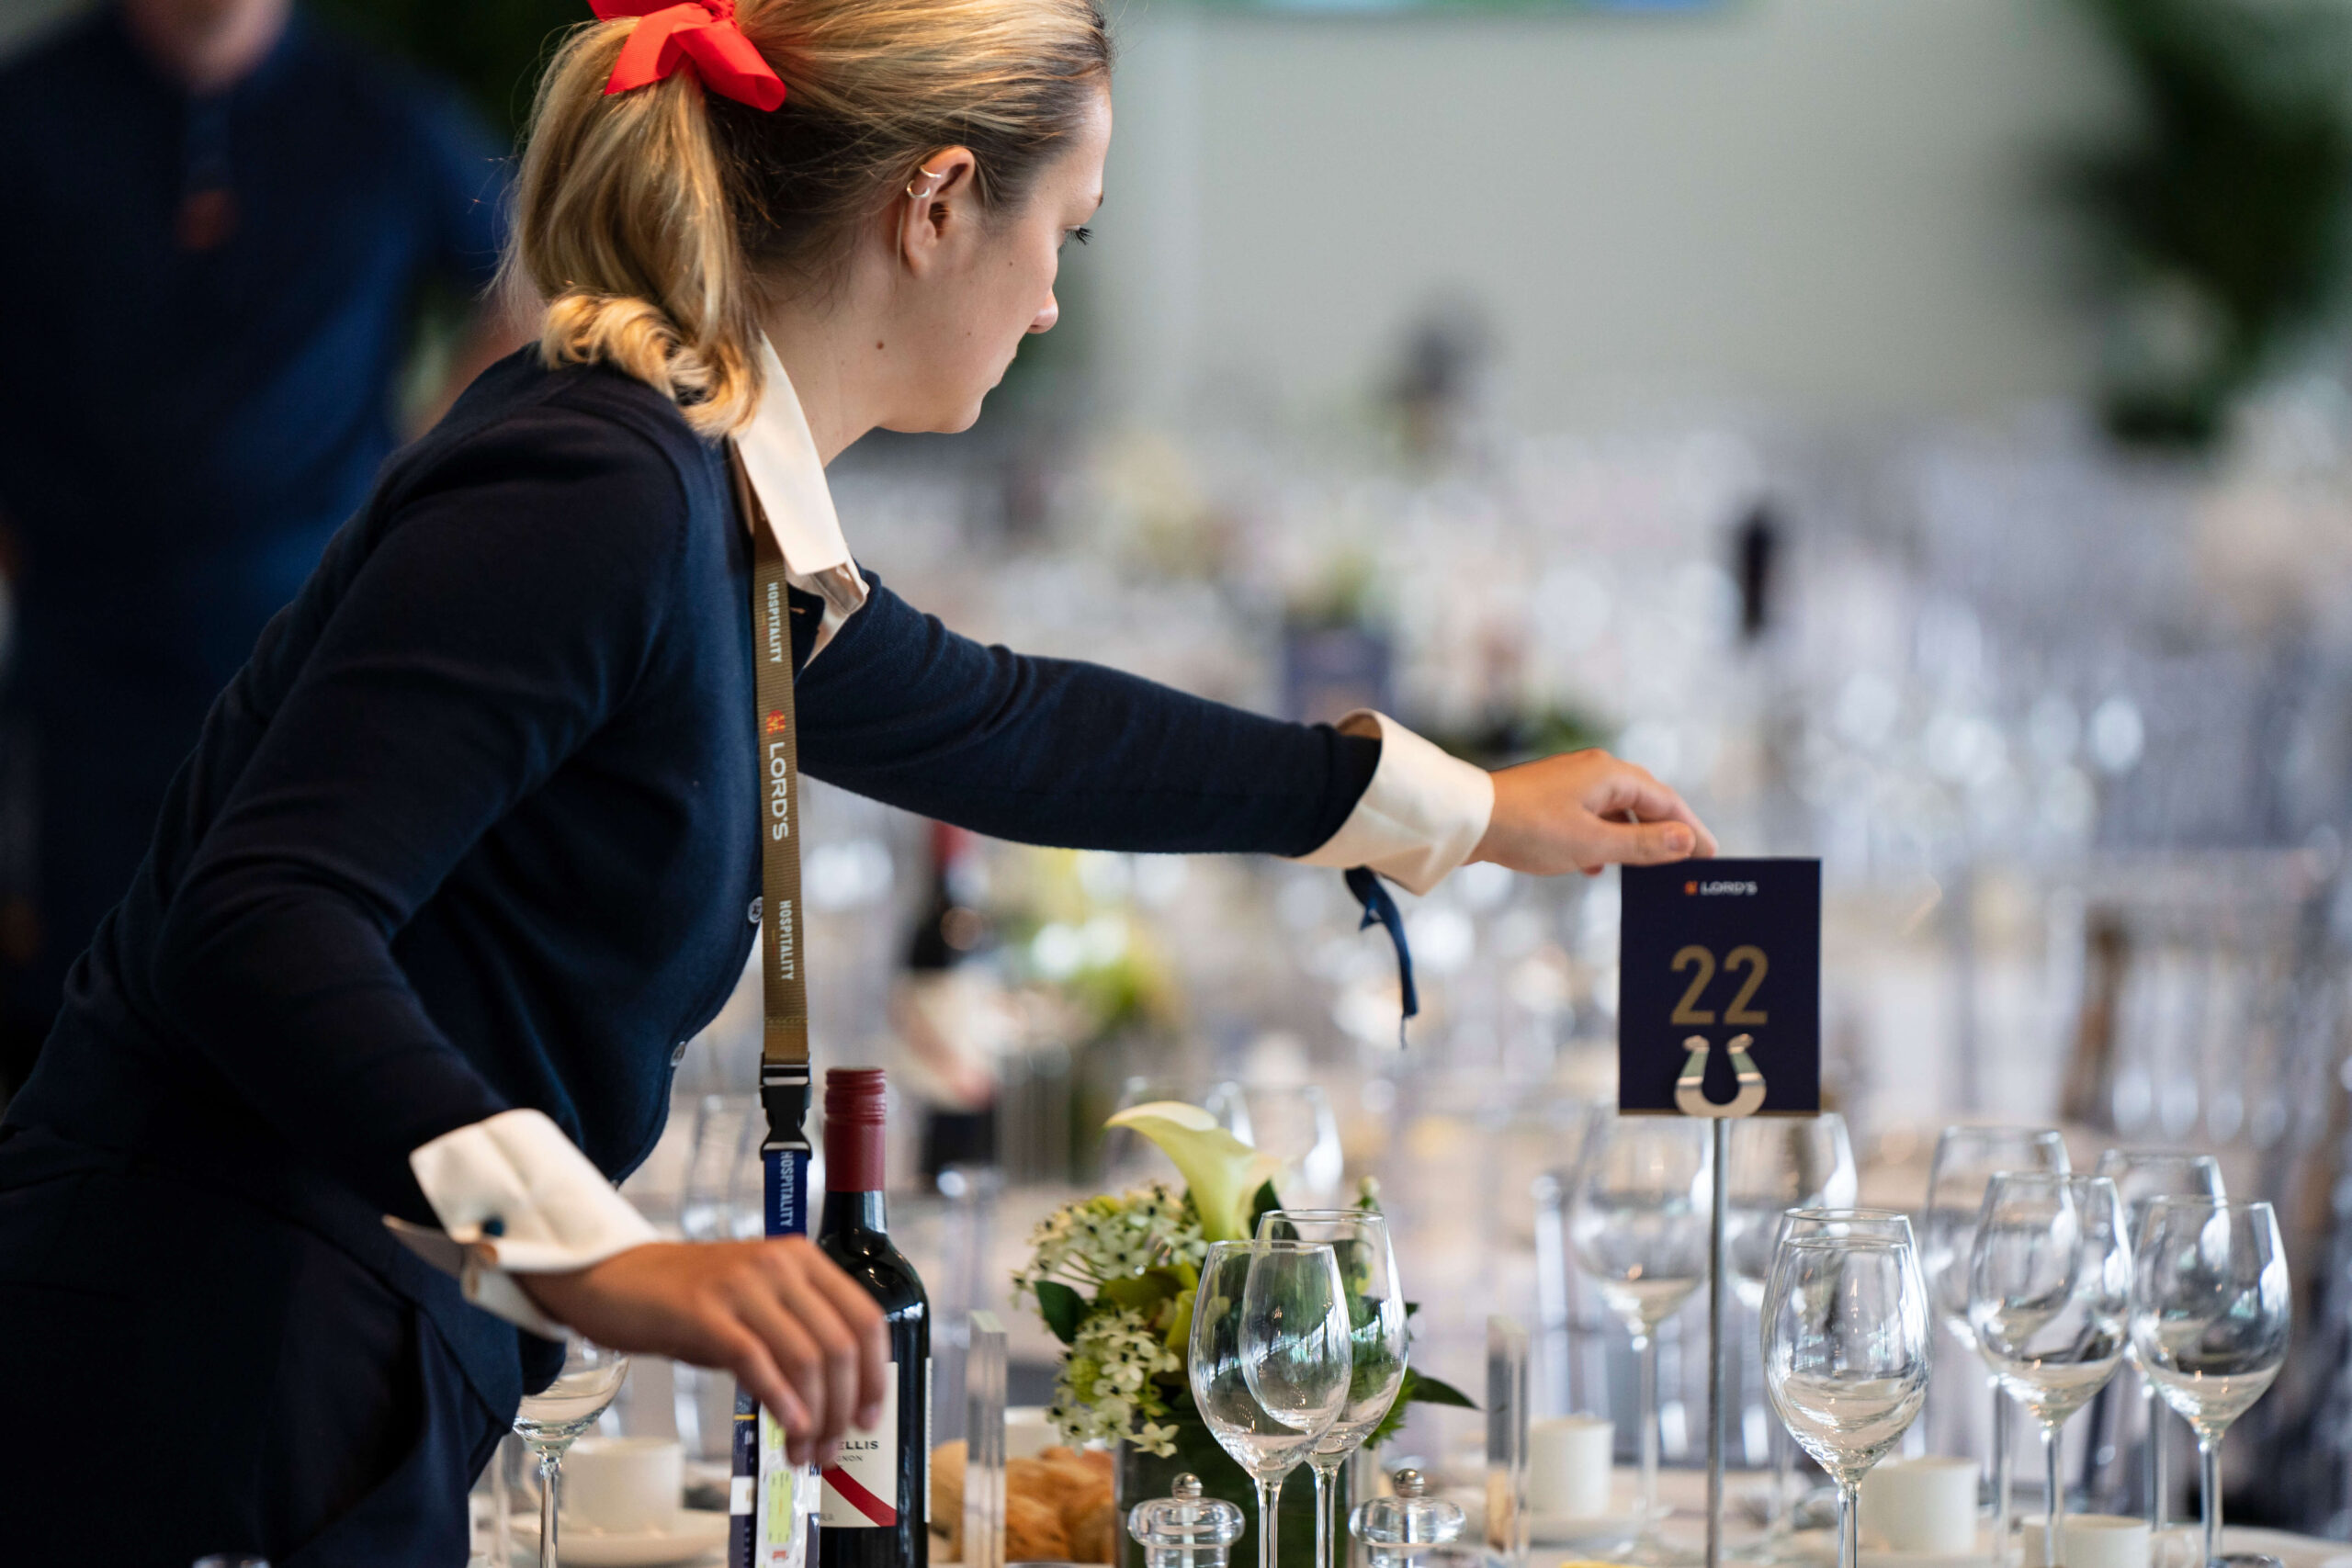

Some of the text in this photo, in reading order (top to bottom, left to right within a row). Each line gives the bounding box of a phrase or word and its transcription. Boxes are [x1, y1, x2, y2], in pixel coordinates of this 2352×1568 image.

[767, 581, 782, 662] HOSPITALITY
[769, 741, 789, 840] LORD'S
[1700, 881, 1758, 896] LORD'S
[779, 900, 794, 980] HOSPITALITY
[1670, 944, 1769, 1025] 22
[780, 1151, 794, 1227] HOSPITALITY
